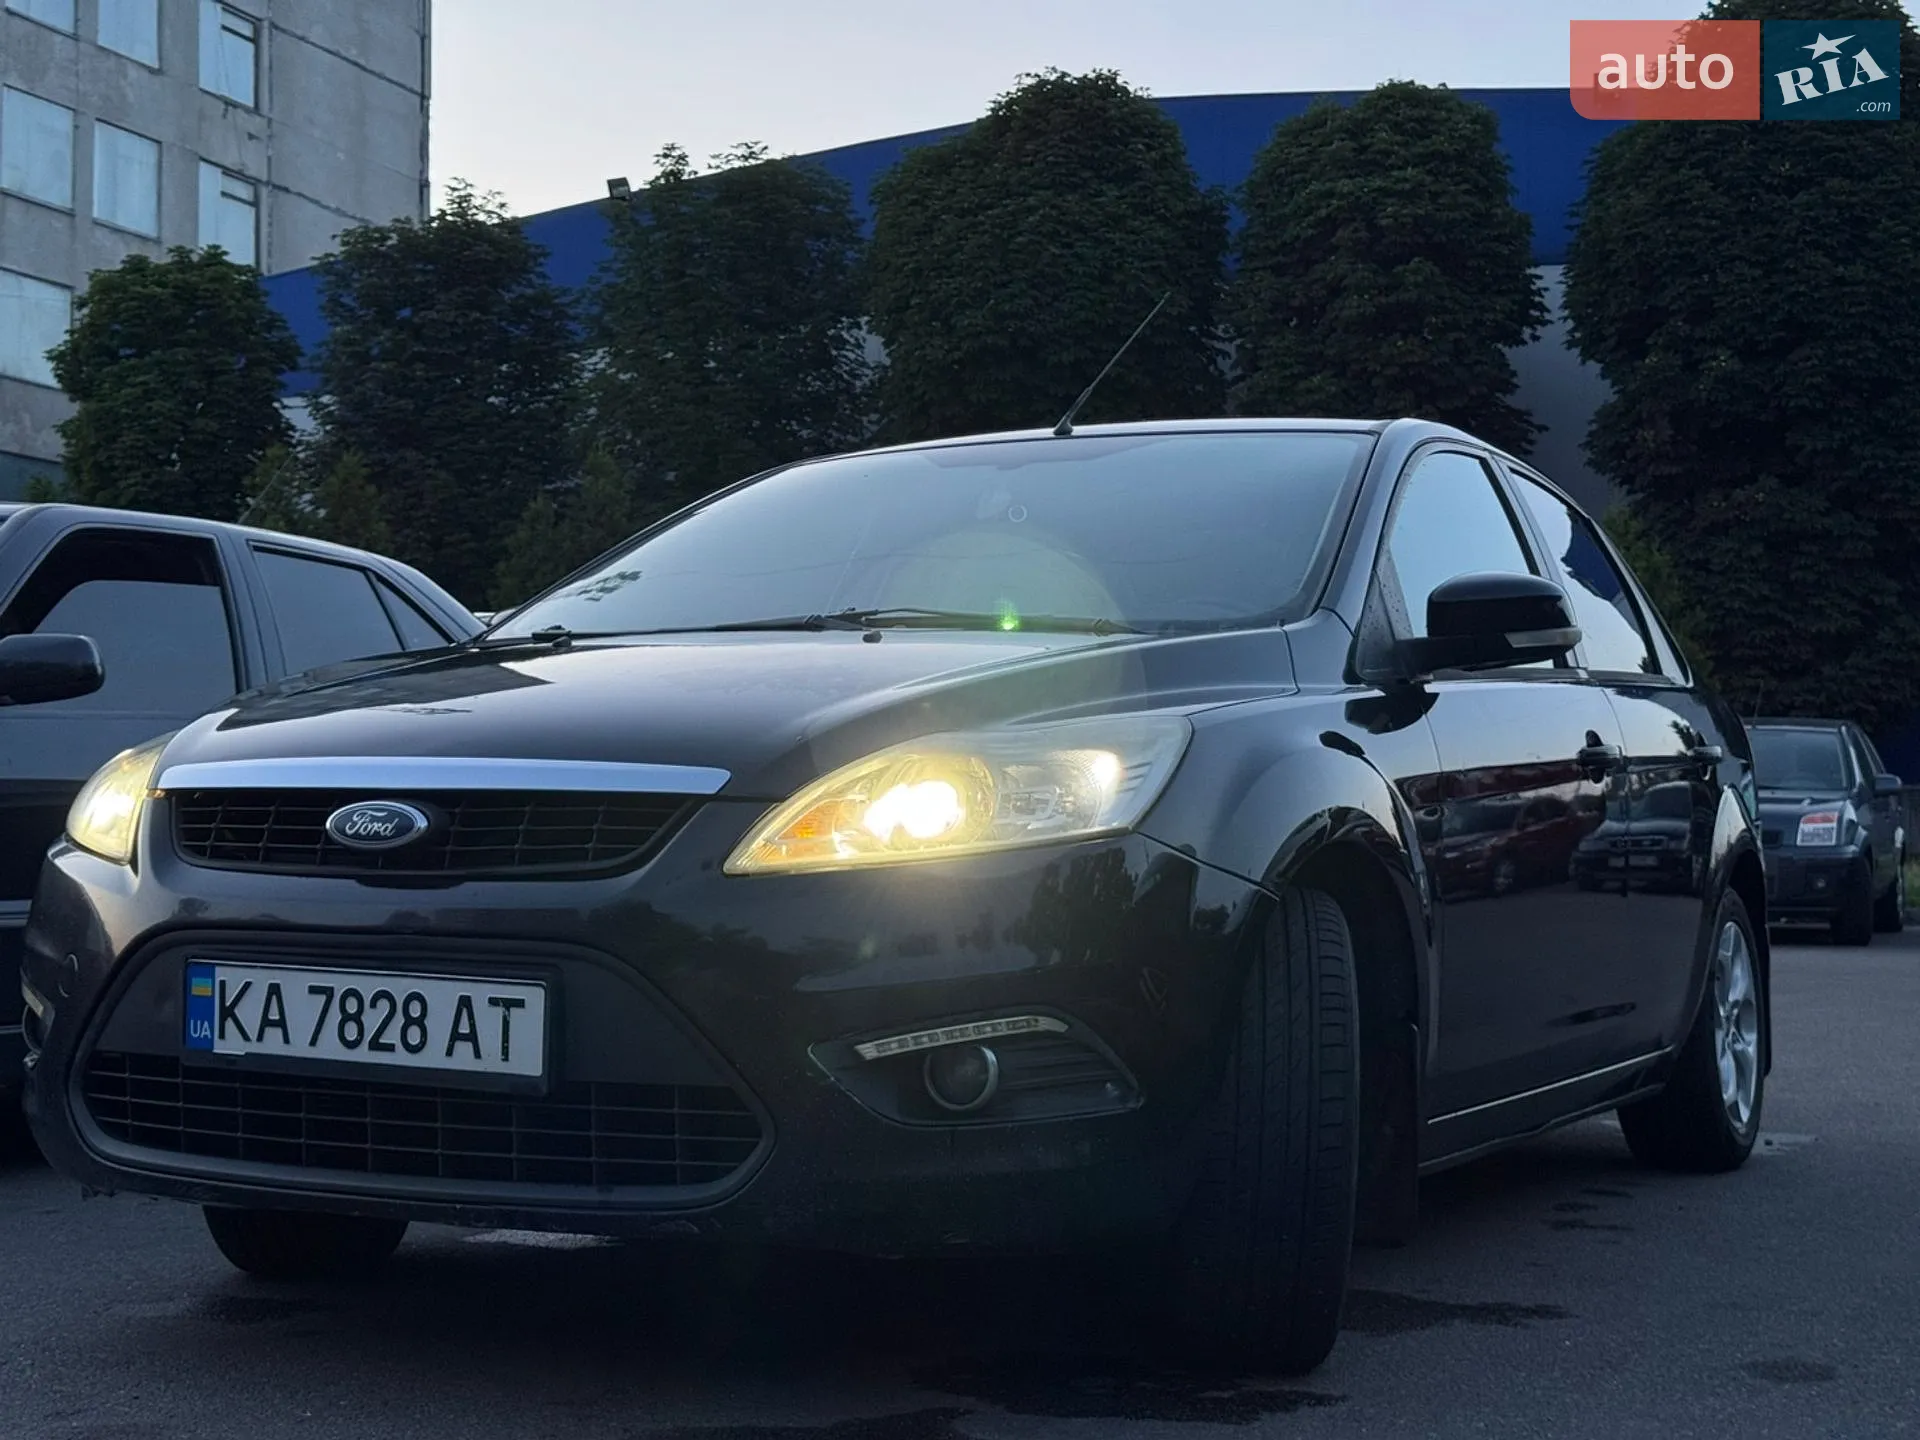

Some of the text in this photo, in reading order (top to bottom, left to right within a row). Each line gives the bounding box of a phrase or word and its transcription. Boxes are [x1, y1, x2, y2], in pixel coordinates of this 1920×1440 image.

[345, 809, 399, 837] Ford
[190, 1018, 212, 1040] UA
[218, 979, 526, 1062] KA 7828 AT
